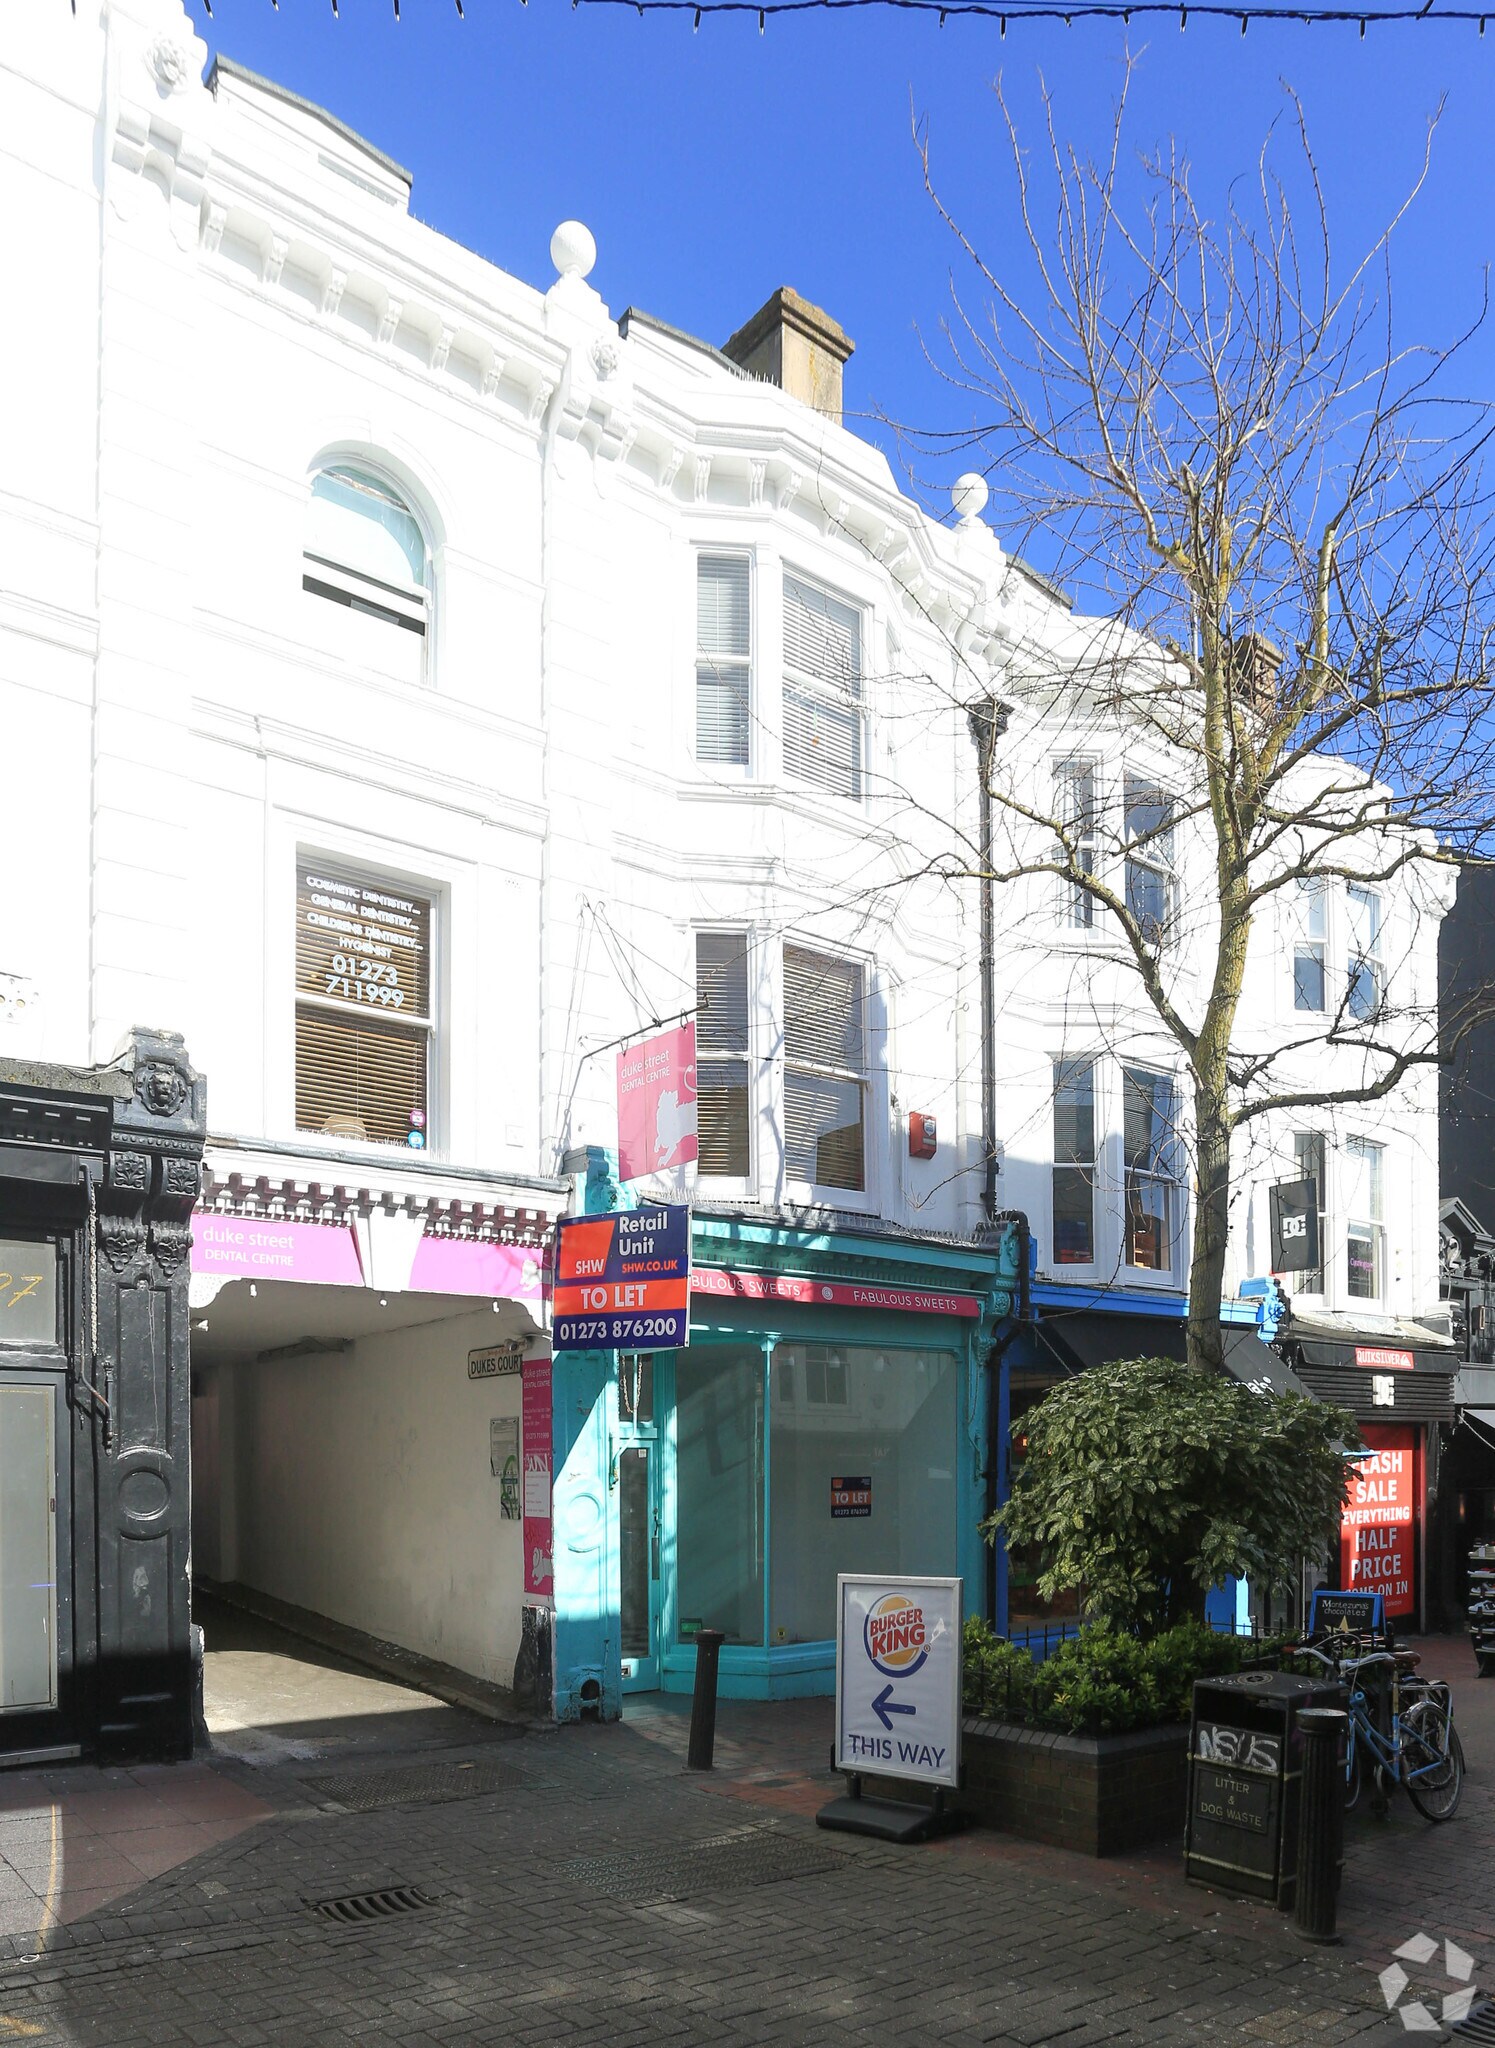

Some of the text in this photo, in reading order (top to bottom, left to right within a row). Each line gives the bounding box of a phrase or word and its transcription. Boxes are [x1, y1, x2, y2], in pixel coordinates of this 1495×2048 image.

[306, 876, 361, 898] COSMETIC
[311, 893, 359, 914] GENERAL
[332, 954, 398, 986] 01273
[325, 974, 404, 1008] 711999
[621, 1050, 670, 1079] duke street
[621, 1066, 670, 1093] DENTAL CENTRE
[619, 1211, 668, 1233] Retail
[203, 1226, 294, 1249] duke street
[619, 1236, 655, 1256] Unit
[205, 1249, 294, 1266] DENTAL CENTRE
[575, 1258, 604, 1275] SHW
[621, 1259, 678, 1274] SHW.CO.UK
[691, 1275, 801, 1296] BULOUS SWEETS
[580, 1284, 647, 1310] TO LET
[853, 1290, 957, 1310] FABULOUS SWEETS
[560, 1317, 677, 1341] 01273 876200
[471, 1354, 523, 1375] DUKES COURT
[1356, 1350, 1401, 1365] QUIKSILVER
[1350, 1452, 1403, 1475] LASH
[834, 1491, 869, 1505] TO LET
[1356, 1480, 1397, 1504] SALE
[1342, 1506, 1410, 1526] EVERYTHING
[1355, 1528, 1397, 1552] HALF
[1351, 1554, 1401, 1581] PRICE
[1378, 1583, 1392, 1596] ON
[1396, 1581, 1408, 1594] IN
[870, 1608, 923, 1637] BURGER
[1324, 1608, 1366, 1617] chocolates
[872, 1623, 925, 1658] KING
[849, 1734, 945, 1768] THIS WAY
[1215, 1777, 1250, 1794] LITTER
[1227, 1795, 1235, 1805] &
[1201, 1802, 1262, 1827] DOG WASTE
